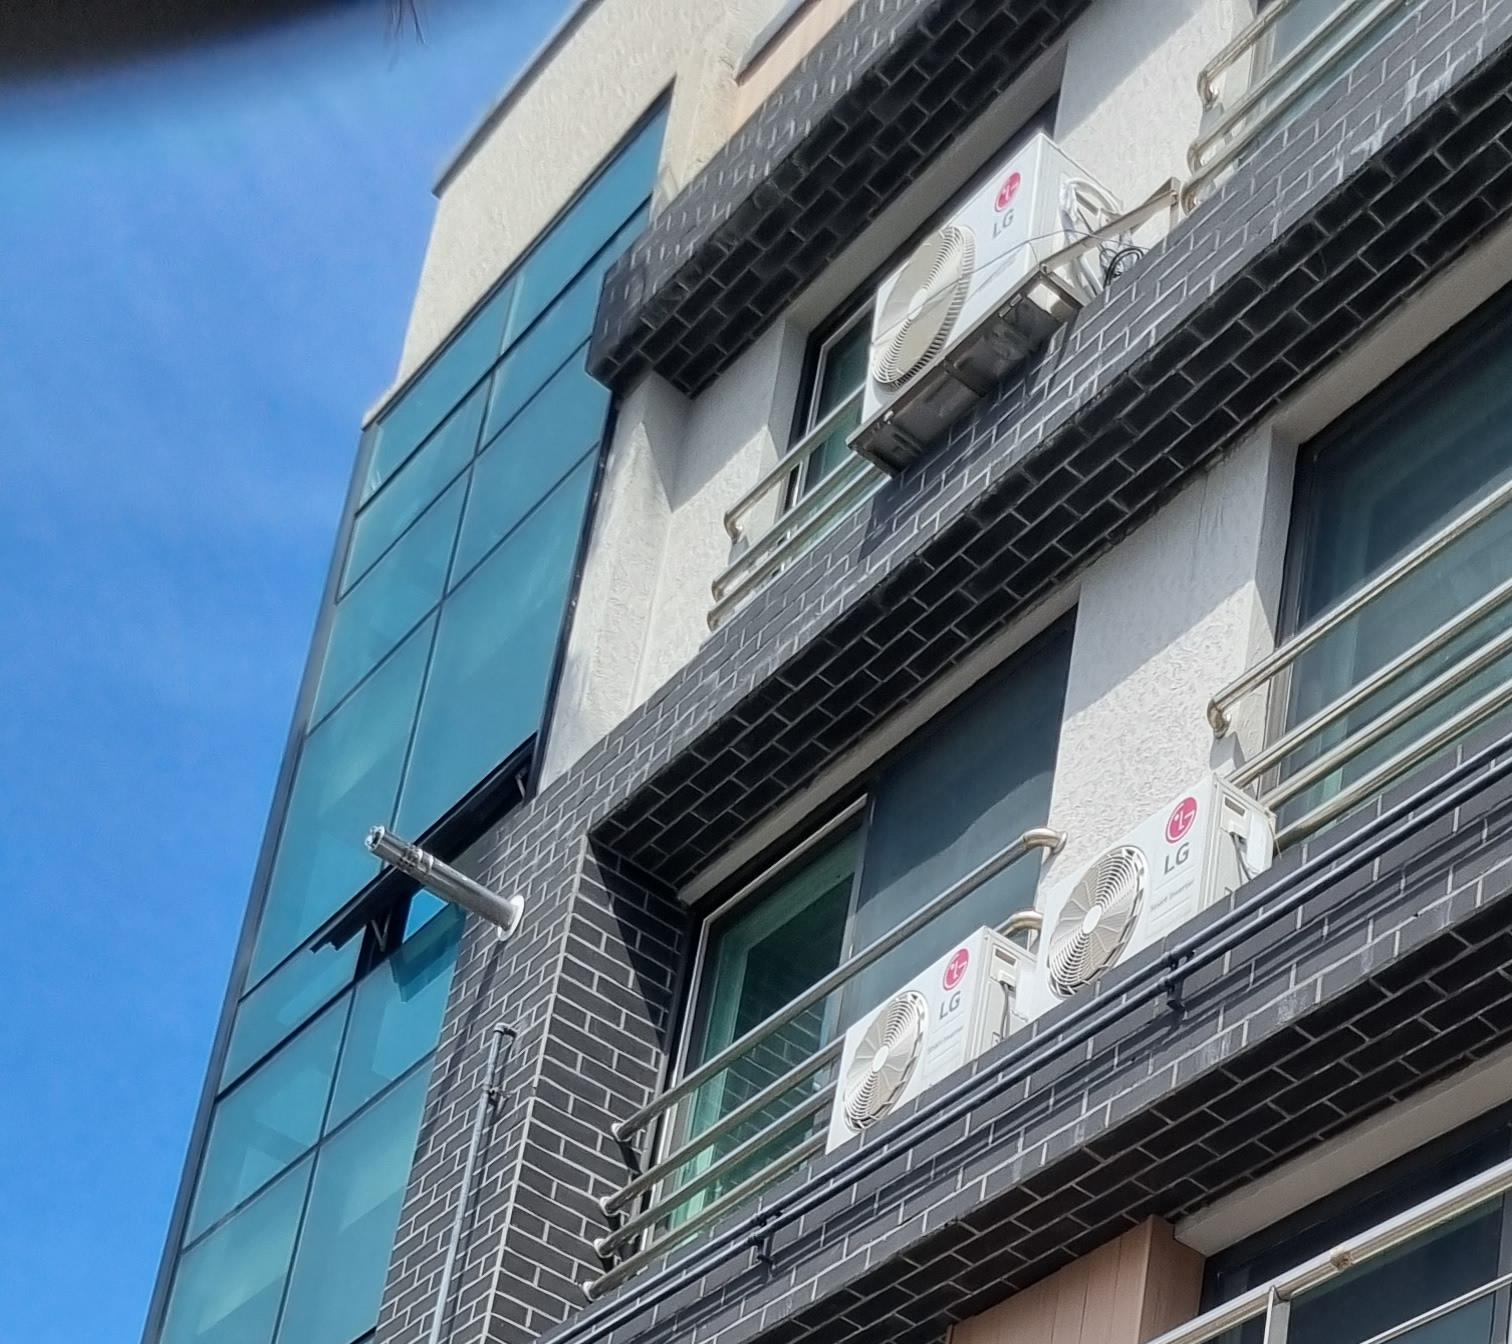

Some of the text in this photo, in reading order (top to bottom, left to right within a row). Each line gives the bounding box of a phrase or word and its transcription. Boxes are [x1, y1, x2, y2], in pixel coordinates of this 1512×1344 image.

[992, 209, 1014, 238] LG
[1164, 842, 1189, 874] LG
[940, 991, 960, 1020] LG
